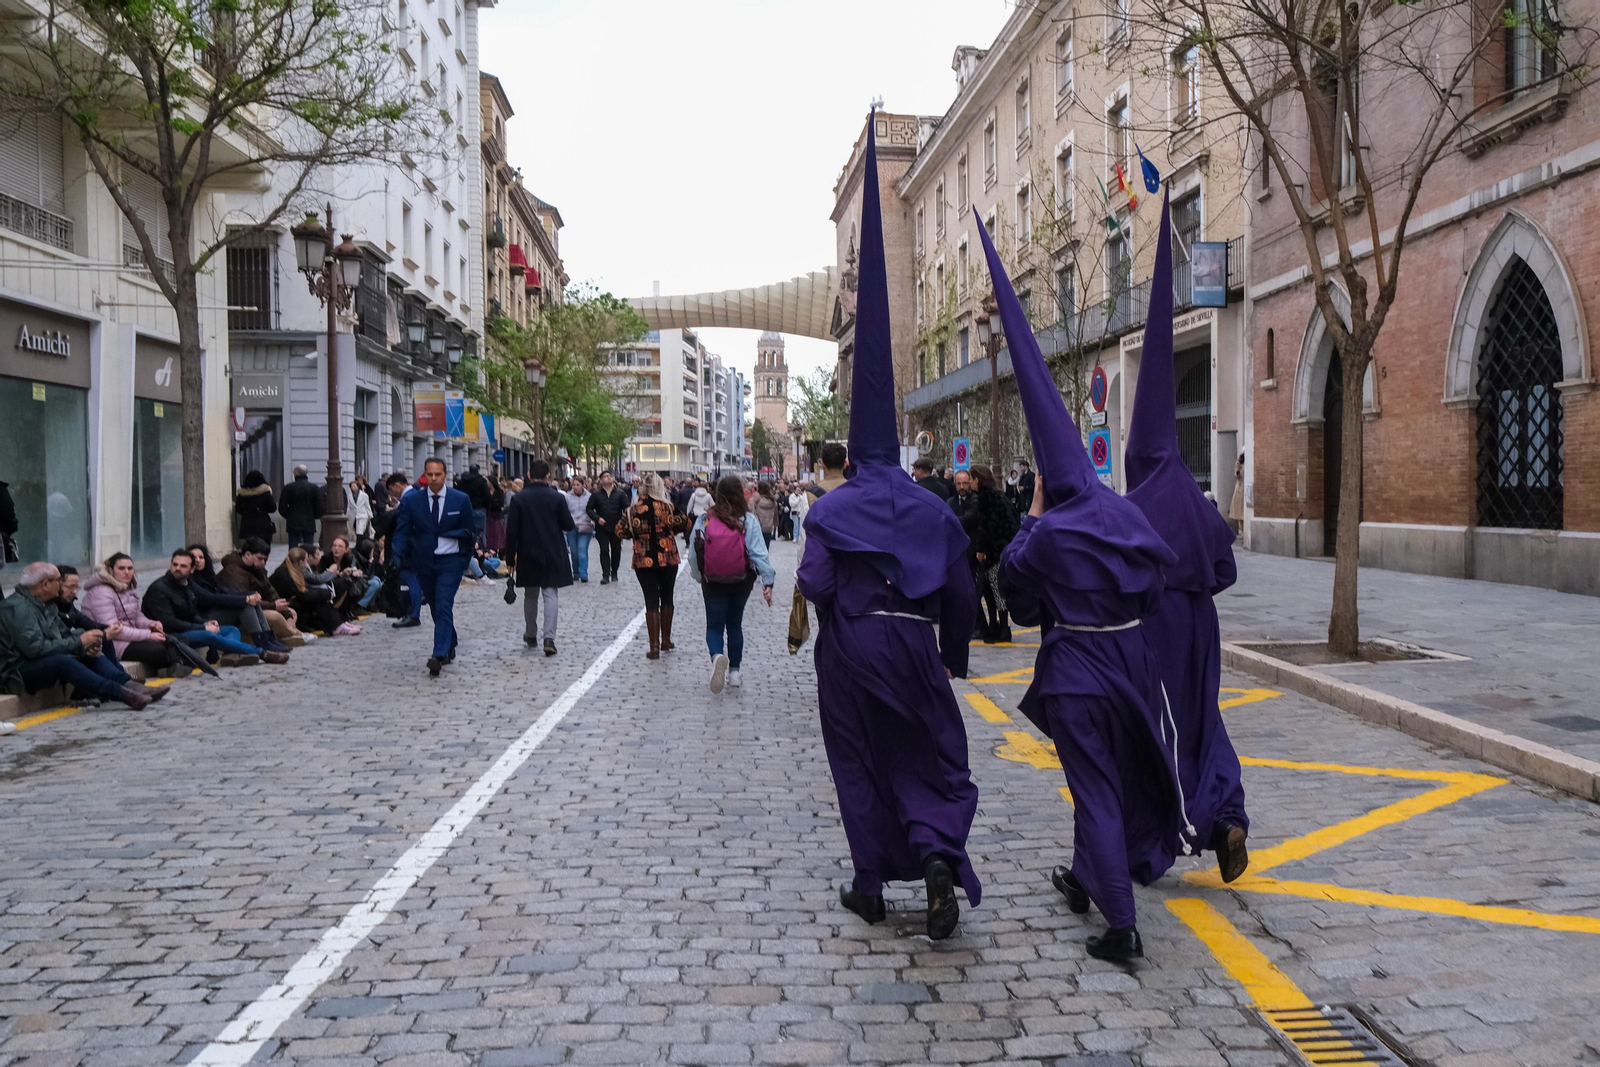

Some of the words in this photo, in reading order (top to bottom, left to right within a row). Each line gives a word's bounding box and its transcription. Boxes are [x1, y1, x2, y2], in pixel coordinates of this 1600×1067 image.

[1196, 309, 1214, 322] SEVILLA
[18, 324, 71, 357] Amichi
[239, 385, 278, 396] Amichi
